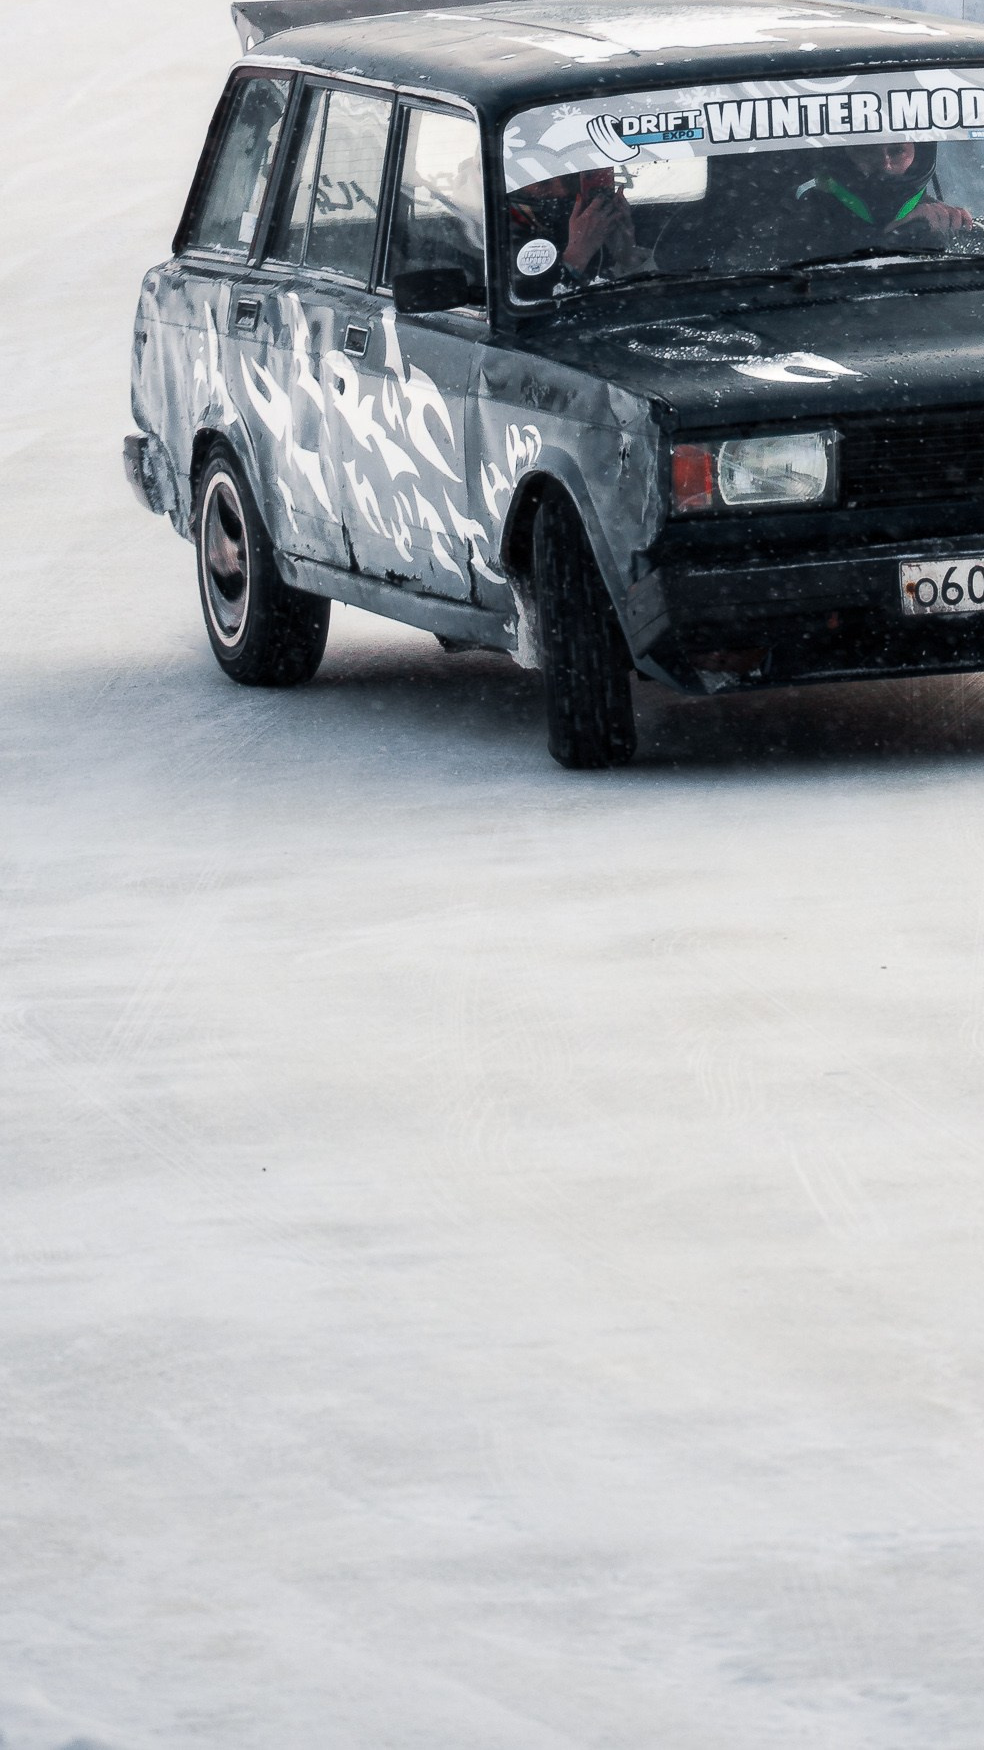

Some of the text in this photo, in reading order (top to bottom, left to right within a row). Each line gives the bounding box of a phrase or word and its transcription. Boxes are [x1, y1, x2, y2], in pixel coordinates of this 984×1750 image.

[621, 110, 701, 136] DRIFT
[704, 90, 881, 143] WINTER
[662, 130, 695, 141] EXPO
